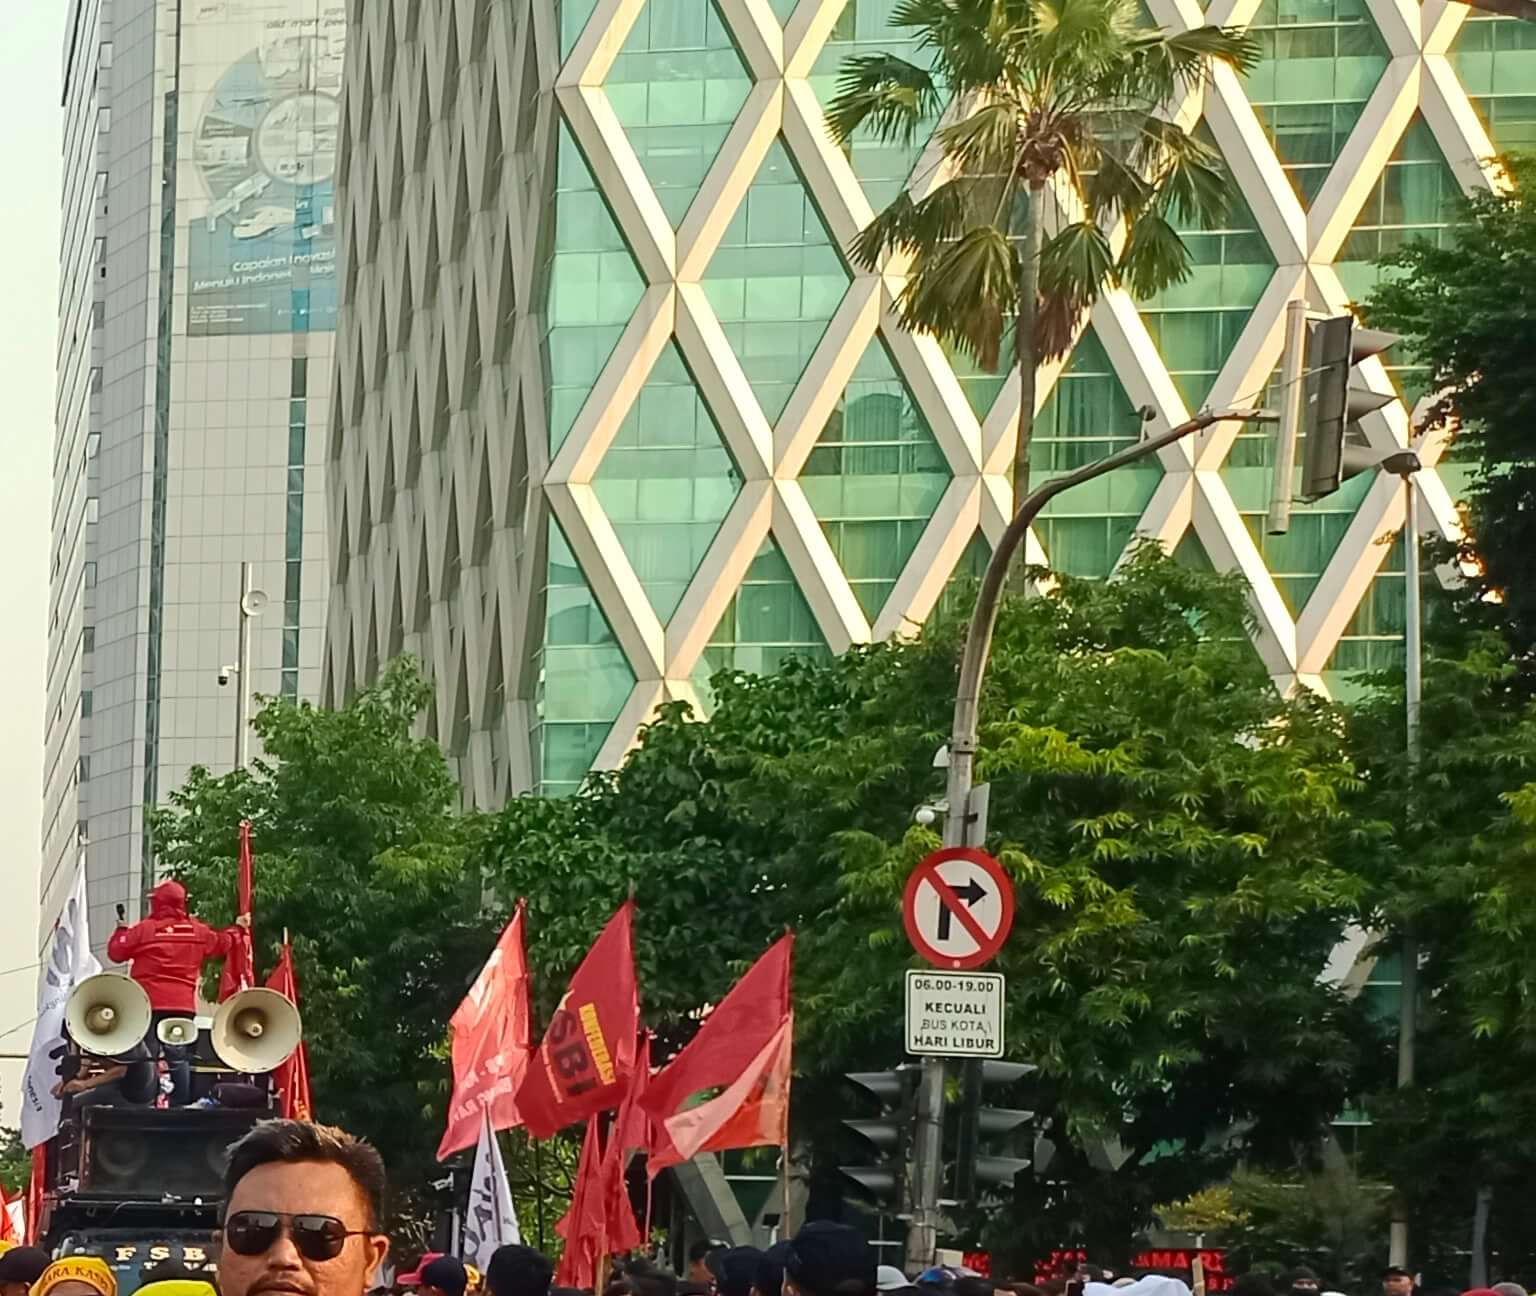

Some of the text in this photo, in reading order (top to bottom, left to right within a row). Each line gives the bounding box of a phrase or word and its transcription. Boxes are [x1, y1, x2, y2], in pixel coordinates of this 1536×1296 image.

[914, 979, 994, 993] 06.00-19.00
[924, 1002, 986, 1015] KECUALI
[921, 1019, 947, 1031] BUS
[913, 1035, 995, 1050] HARI LIBUR
